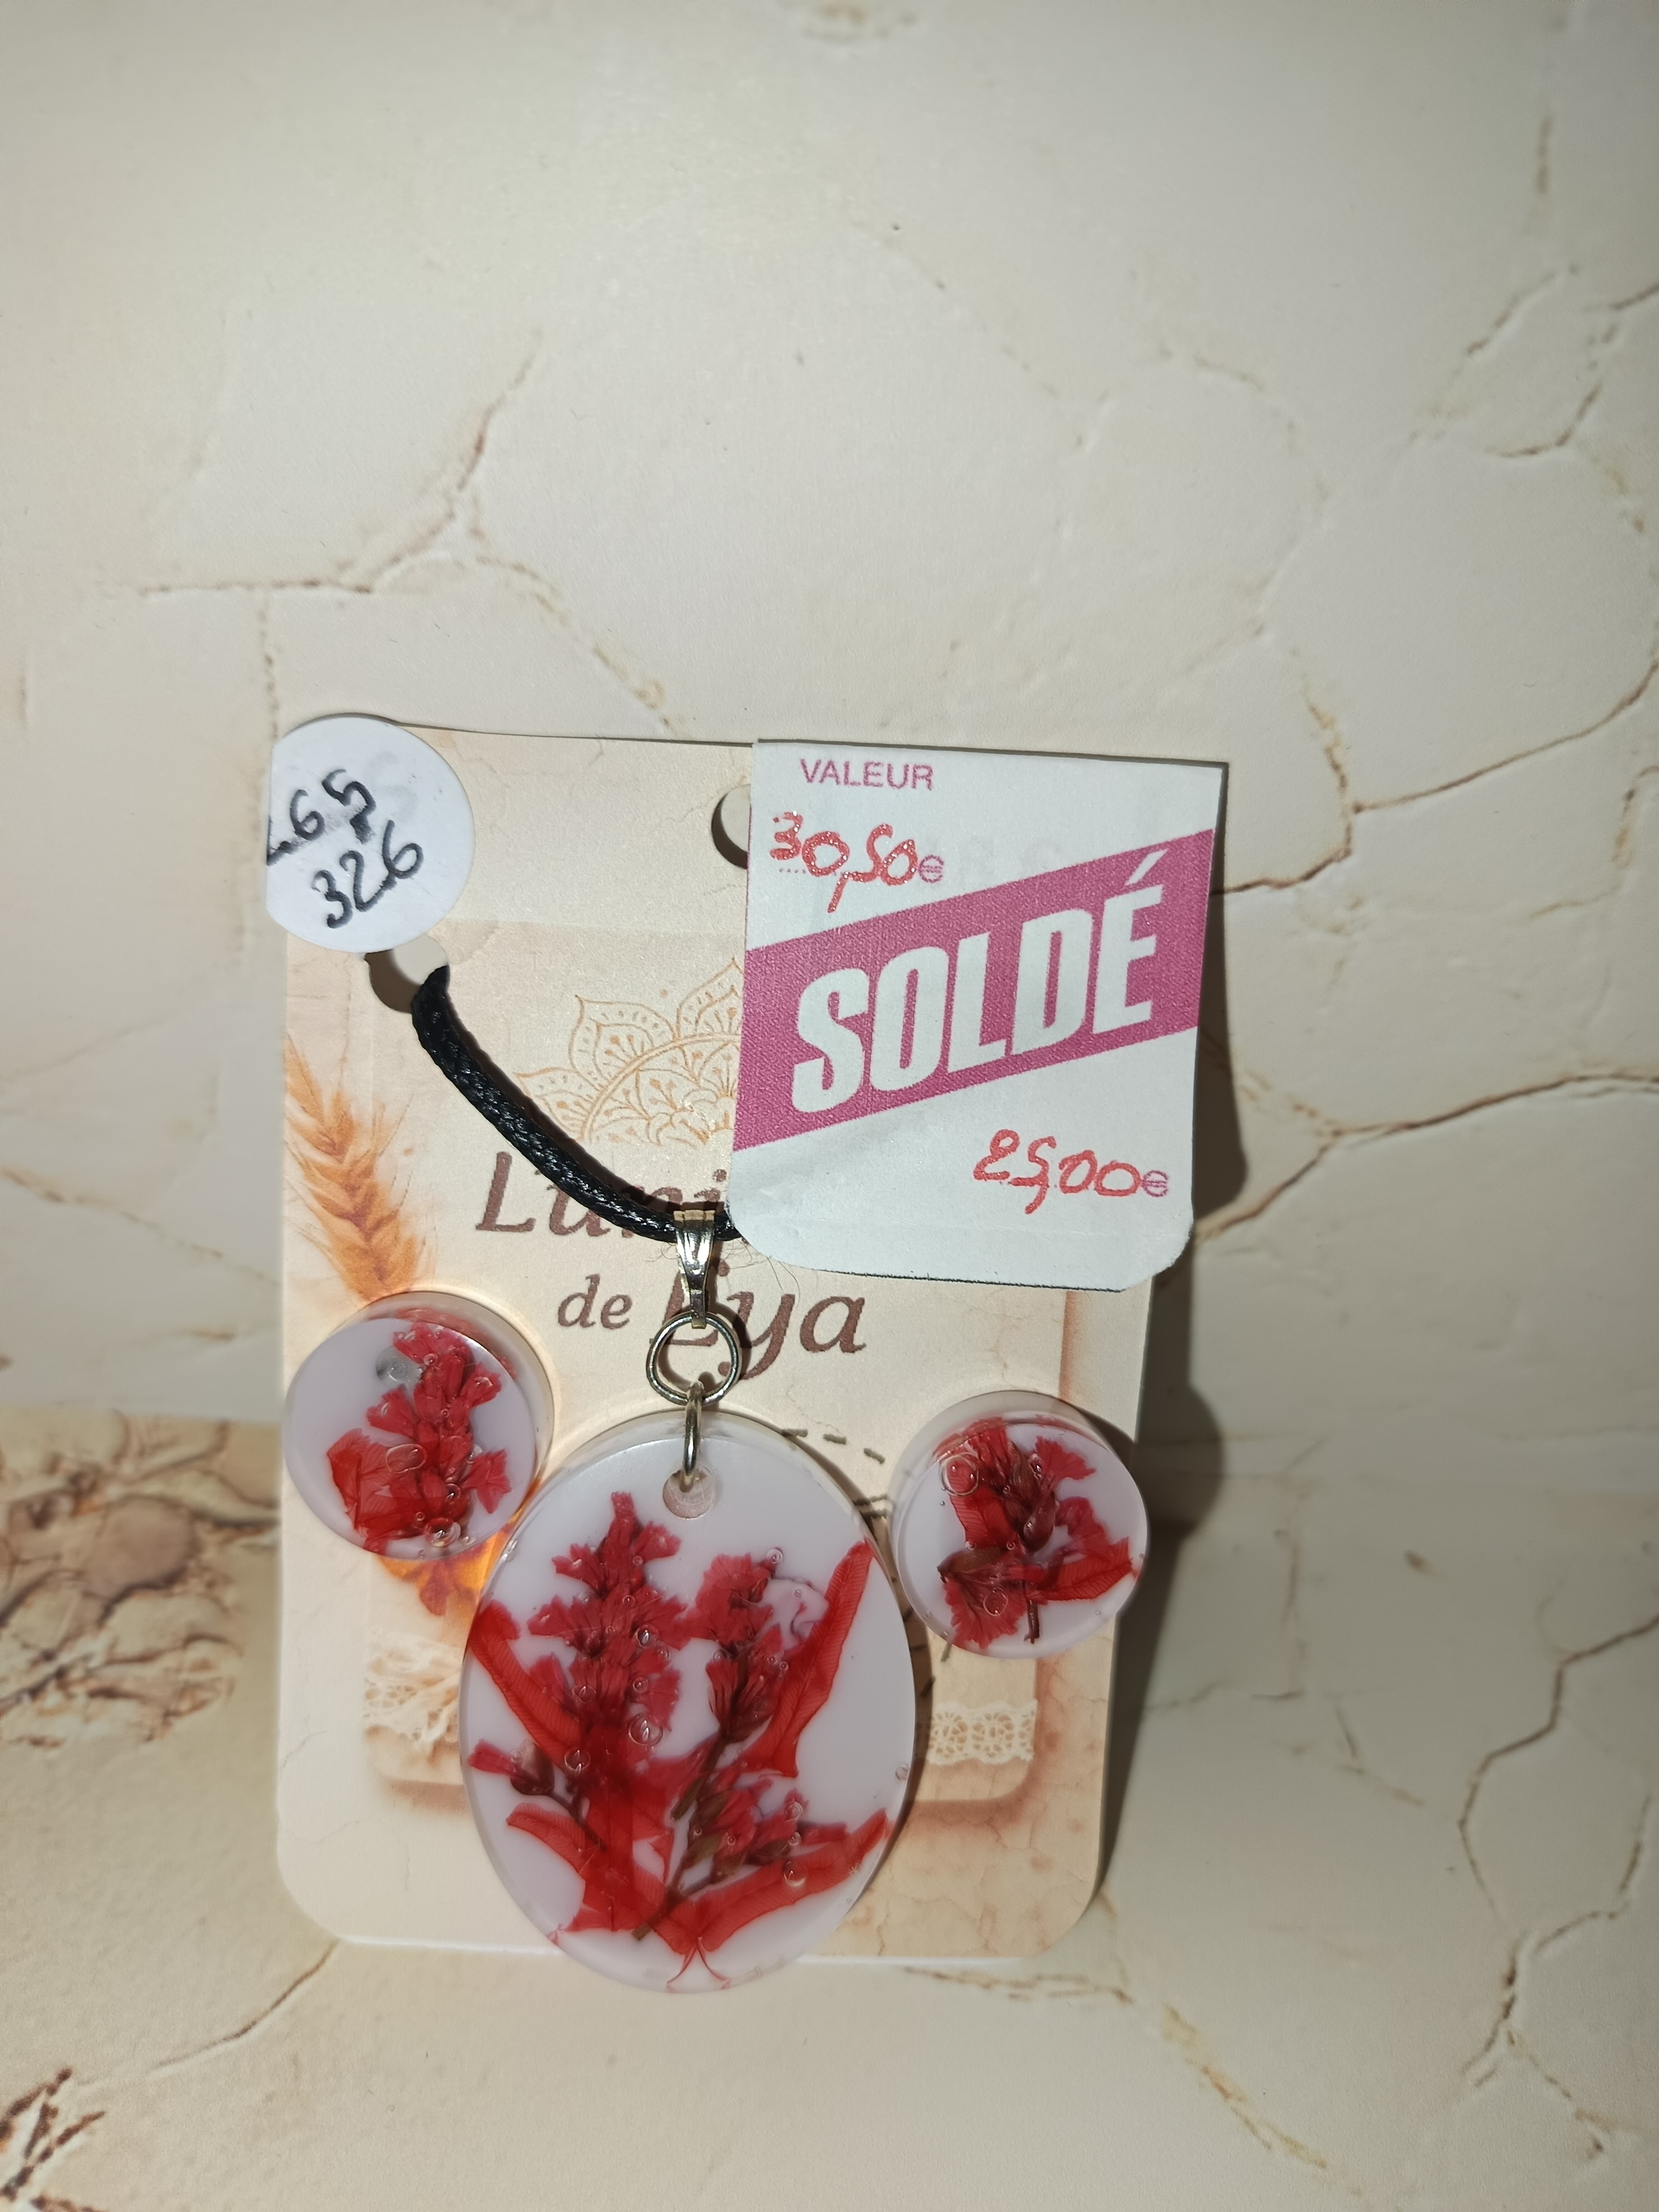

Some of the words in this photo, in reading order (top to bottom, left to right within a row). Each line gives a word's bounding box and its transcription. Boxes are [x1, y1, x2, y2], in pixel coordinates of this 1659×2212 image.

[800, 759, 933, 790] VALEUR
[311, 820, 425, 930] 326
[792, 849, 1168, 1113] SOLDÉ
[557, 1274, 632, 1329] de
